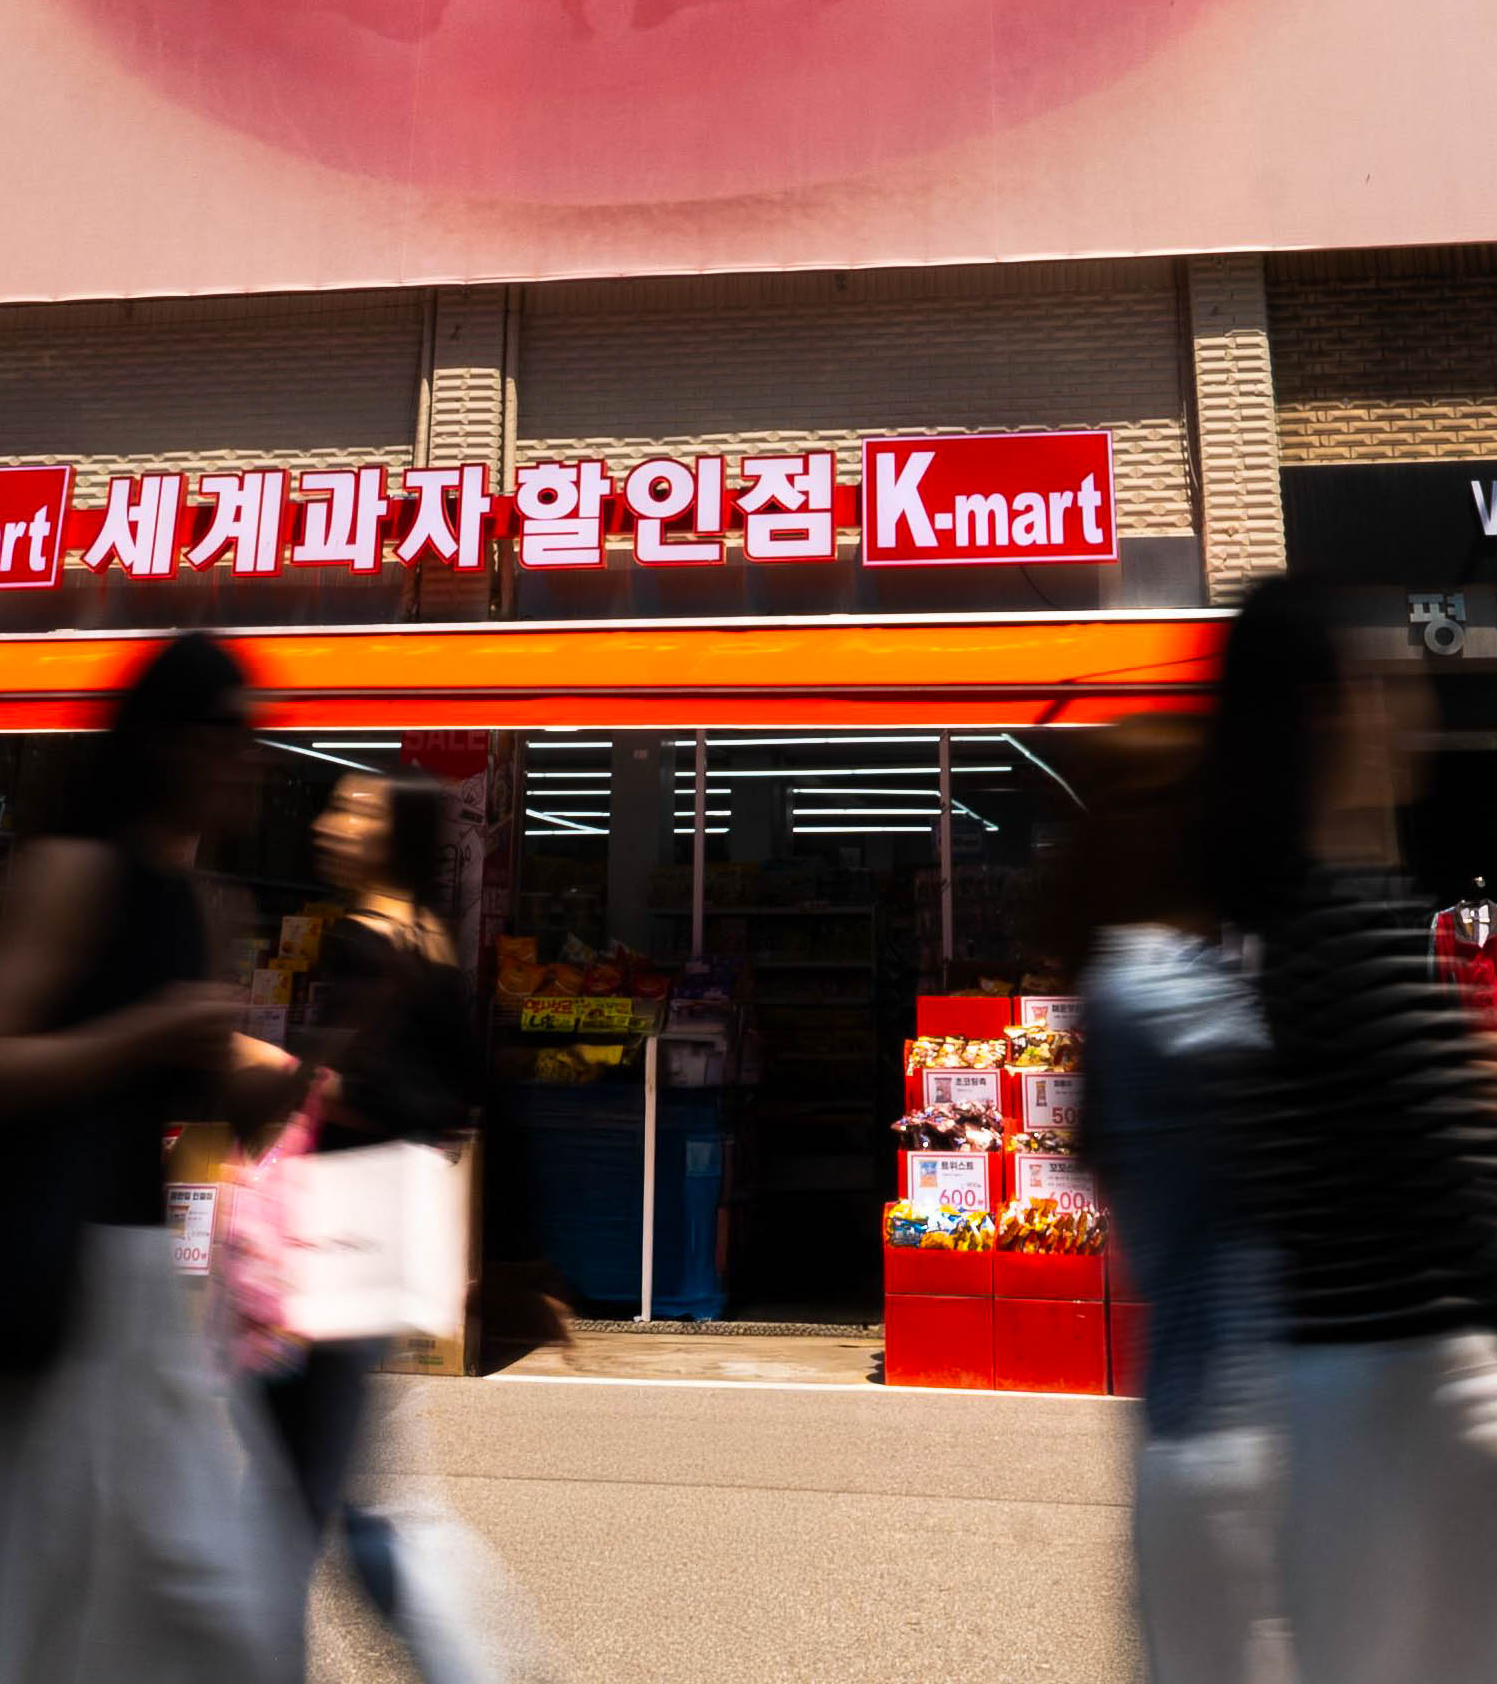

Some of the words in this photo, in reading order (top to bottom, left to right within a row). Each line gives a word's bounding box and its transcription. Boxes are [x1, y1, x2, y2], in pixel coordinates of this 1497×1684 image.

[83, 464, 491, 577] 세계과자
[515, 450, 835, 566] 할인점
[874, 450, 1103, 549] K-mart
[1051, 1106, 1081, 1124] 50
